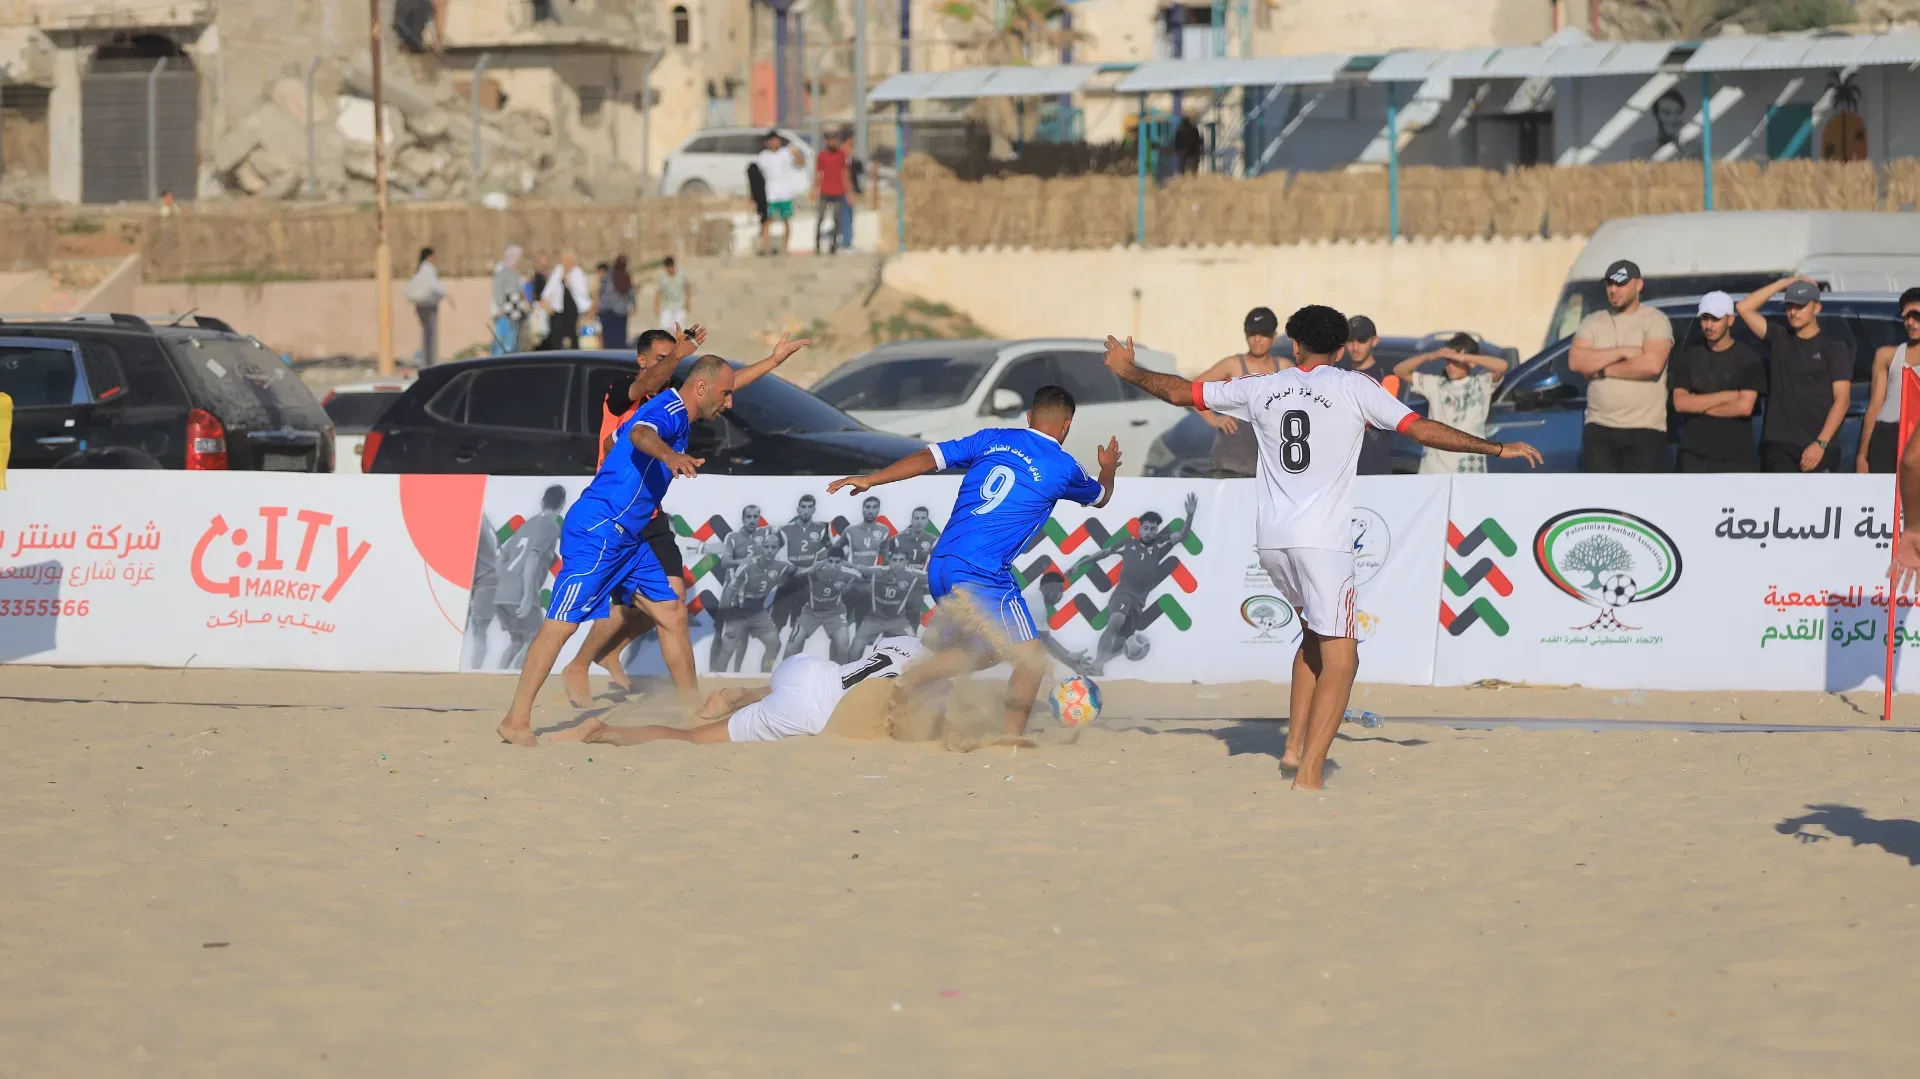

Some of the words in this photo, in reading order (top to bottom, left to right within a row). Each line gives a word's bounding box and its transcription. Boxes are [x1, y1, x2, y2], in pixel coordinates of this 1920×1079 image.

[1263, 387, 1295, 411] الرياضي
[1299, 387, 1312, 398] غزة
[1314, 395, 1333, 409] نادي
[1279, 409, 1312, 474] 8
[970, 464, 1016, 516] 9
[11, 523, 77, 558] سنتر
[86, 519, 161, 559] شركة
[1715, 506, 1842, 549] السابعة
[1565, 523, 1605, 538] Palestinian
[1607, 523, 1637, 540] Football
[1637, 535, 1663, 571] Association
[68, 559, 116, 588] شارع
[122, 562, 156, 587] غزة
[1763, 585, 1863, 613] المجتمعية
[206, 610, 272, 629] ماركت
[277, 613, 336, 635] سيتي
[1760, 619, 1824, 648] القدم
[1830, 619, 1876, 648] لكرة
